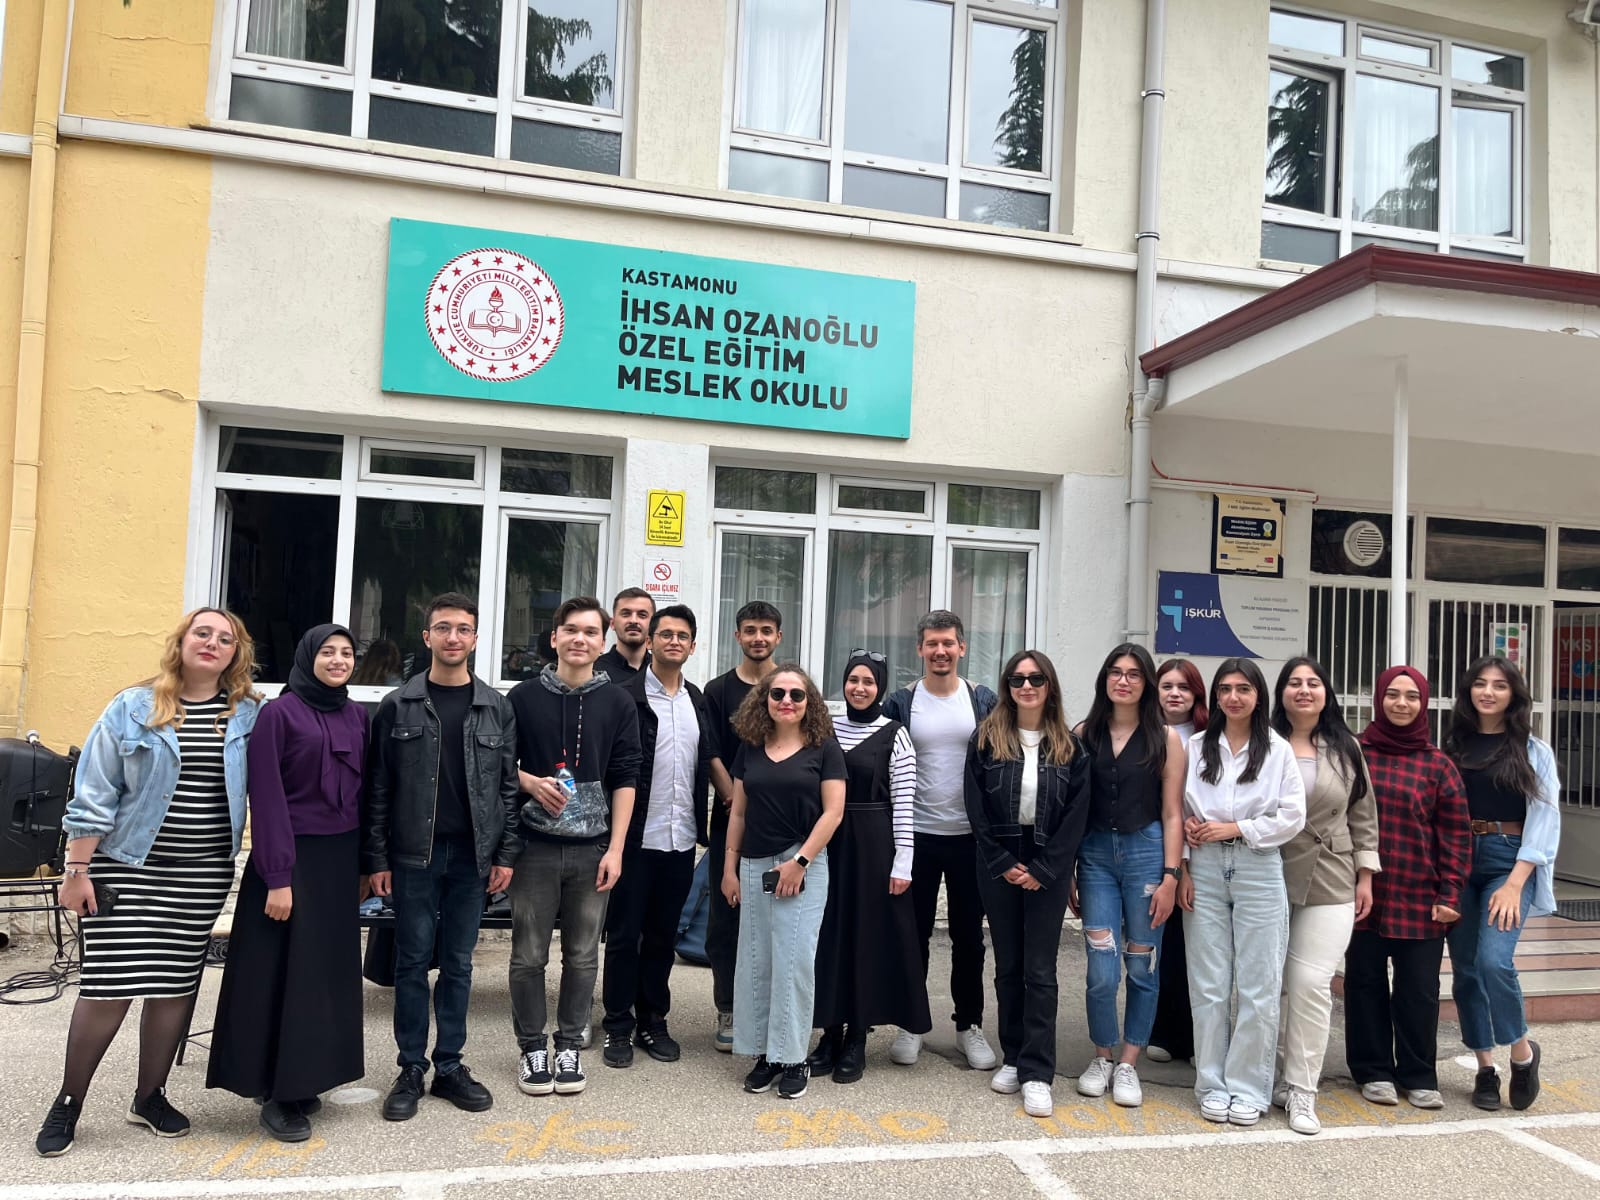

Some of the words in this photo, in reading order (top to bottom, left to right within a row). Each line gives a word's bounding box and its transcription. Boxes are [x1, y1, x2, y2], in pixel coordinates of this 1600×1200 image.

[451, 271, 492, 319] CUMHURİYETİ
[494, 272, 521, 286] MİLLİ
[622, 267, 737, 295] KASTAMONU
[519, 285, 540, 315] EĞİTİM
[620, 290, 714, 331] İHSAN
[724, 309, 878, 348] OZANOĞLU
[453, 322, 485, 355] TÜRKİYE
[504, 318, 539, 356] BAKANLIĞI
[619, 324, 695, 362] ÖZEL
[704, 337, 805, 374] EĞİTİM
[617, 365, 742, 401] MESLEK
[751, 379, 848, 411] OKULU
